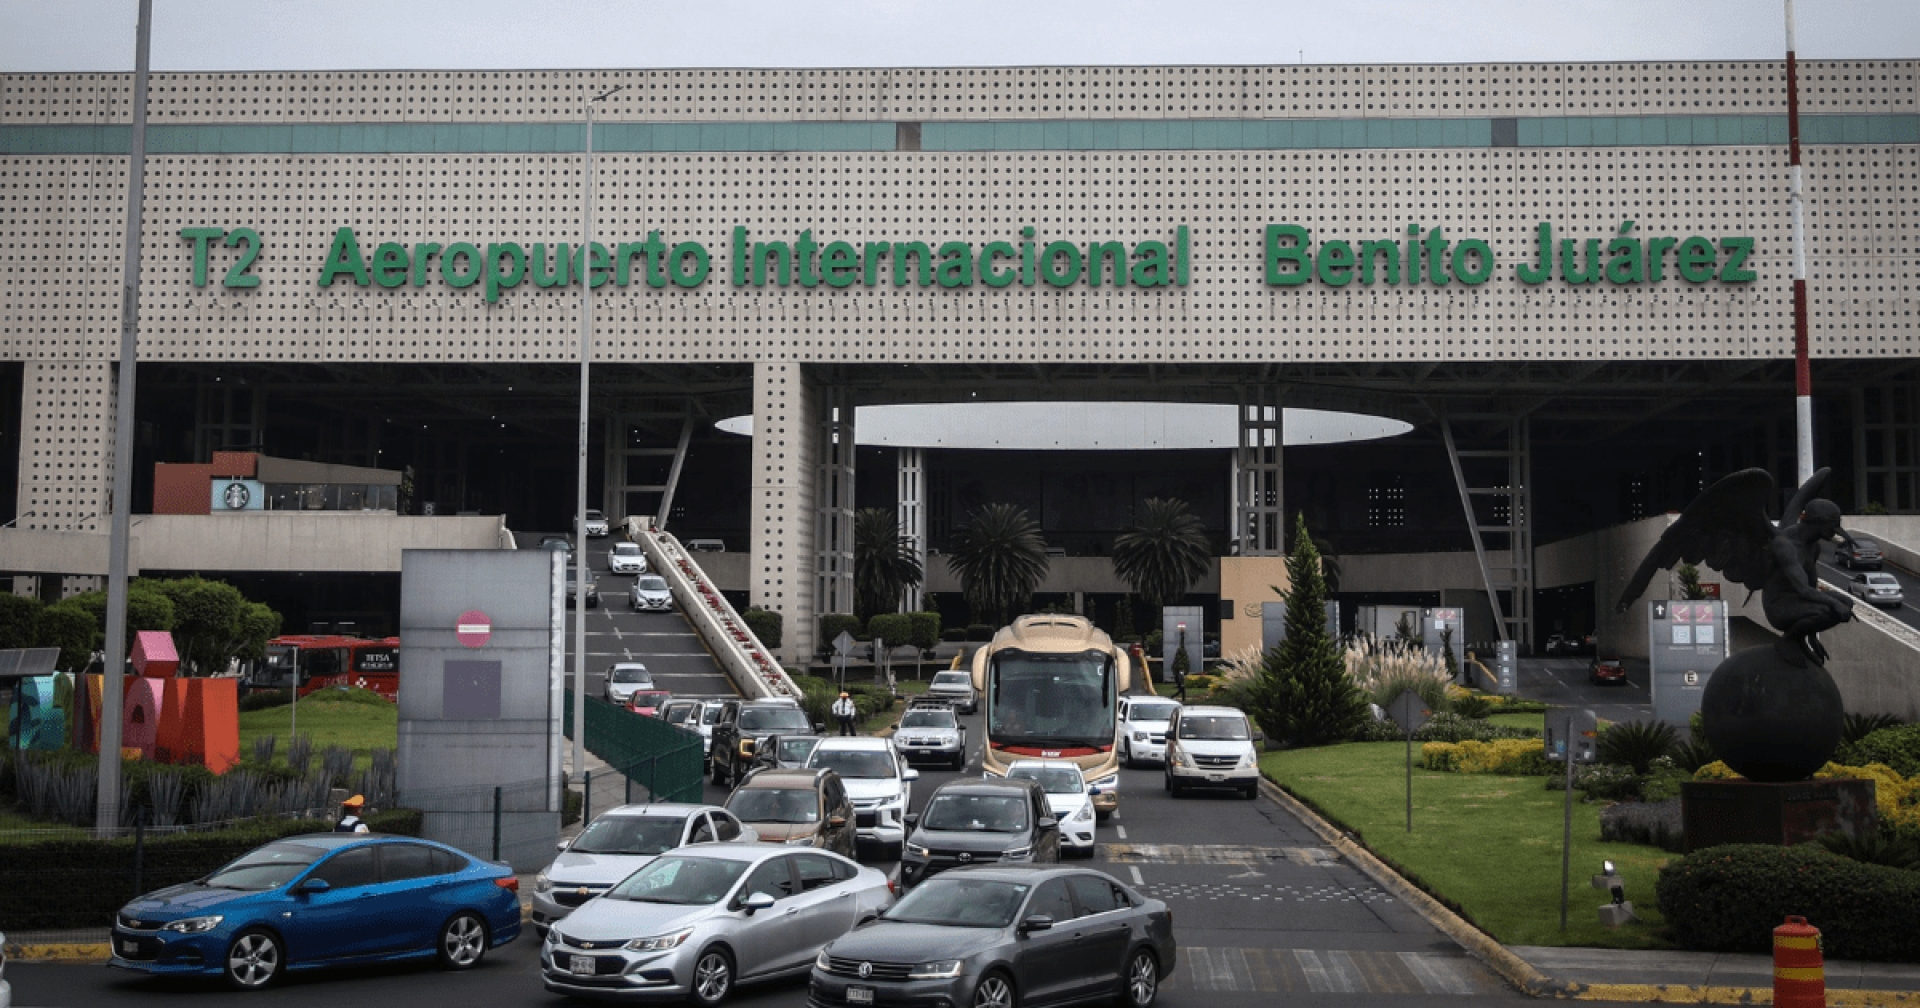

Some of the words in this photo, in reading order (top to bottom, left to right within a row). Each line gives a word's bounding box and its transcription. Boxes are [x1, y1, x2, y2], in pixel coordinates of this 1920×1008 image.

[180, 226, 262, 288] T2
[316, 225, 712, 304] Aeropuerto
[731, 224, 1190, 289] Internacional
[1265, 223, 1495, 287] Benito
[1516, 219, 1758, 285] Juárez
